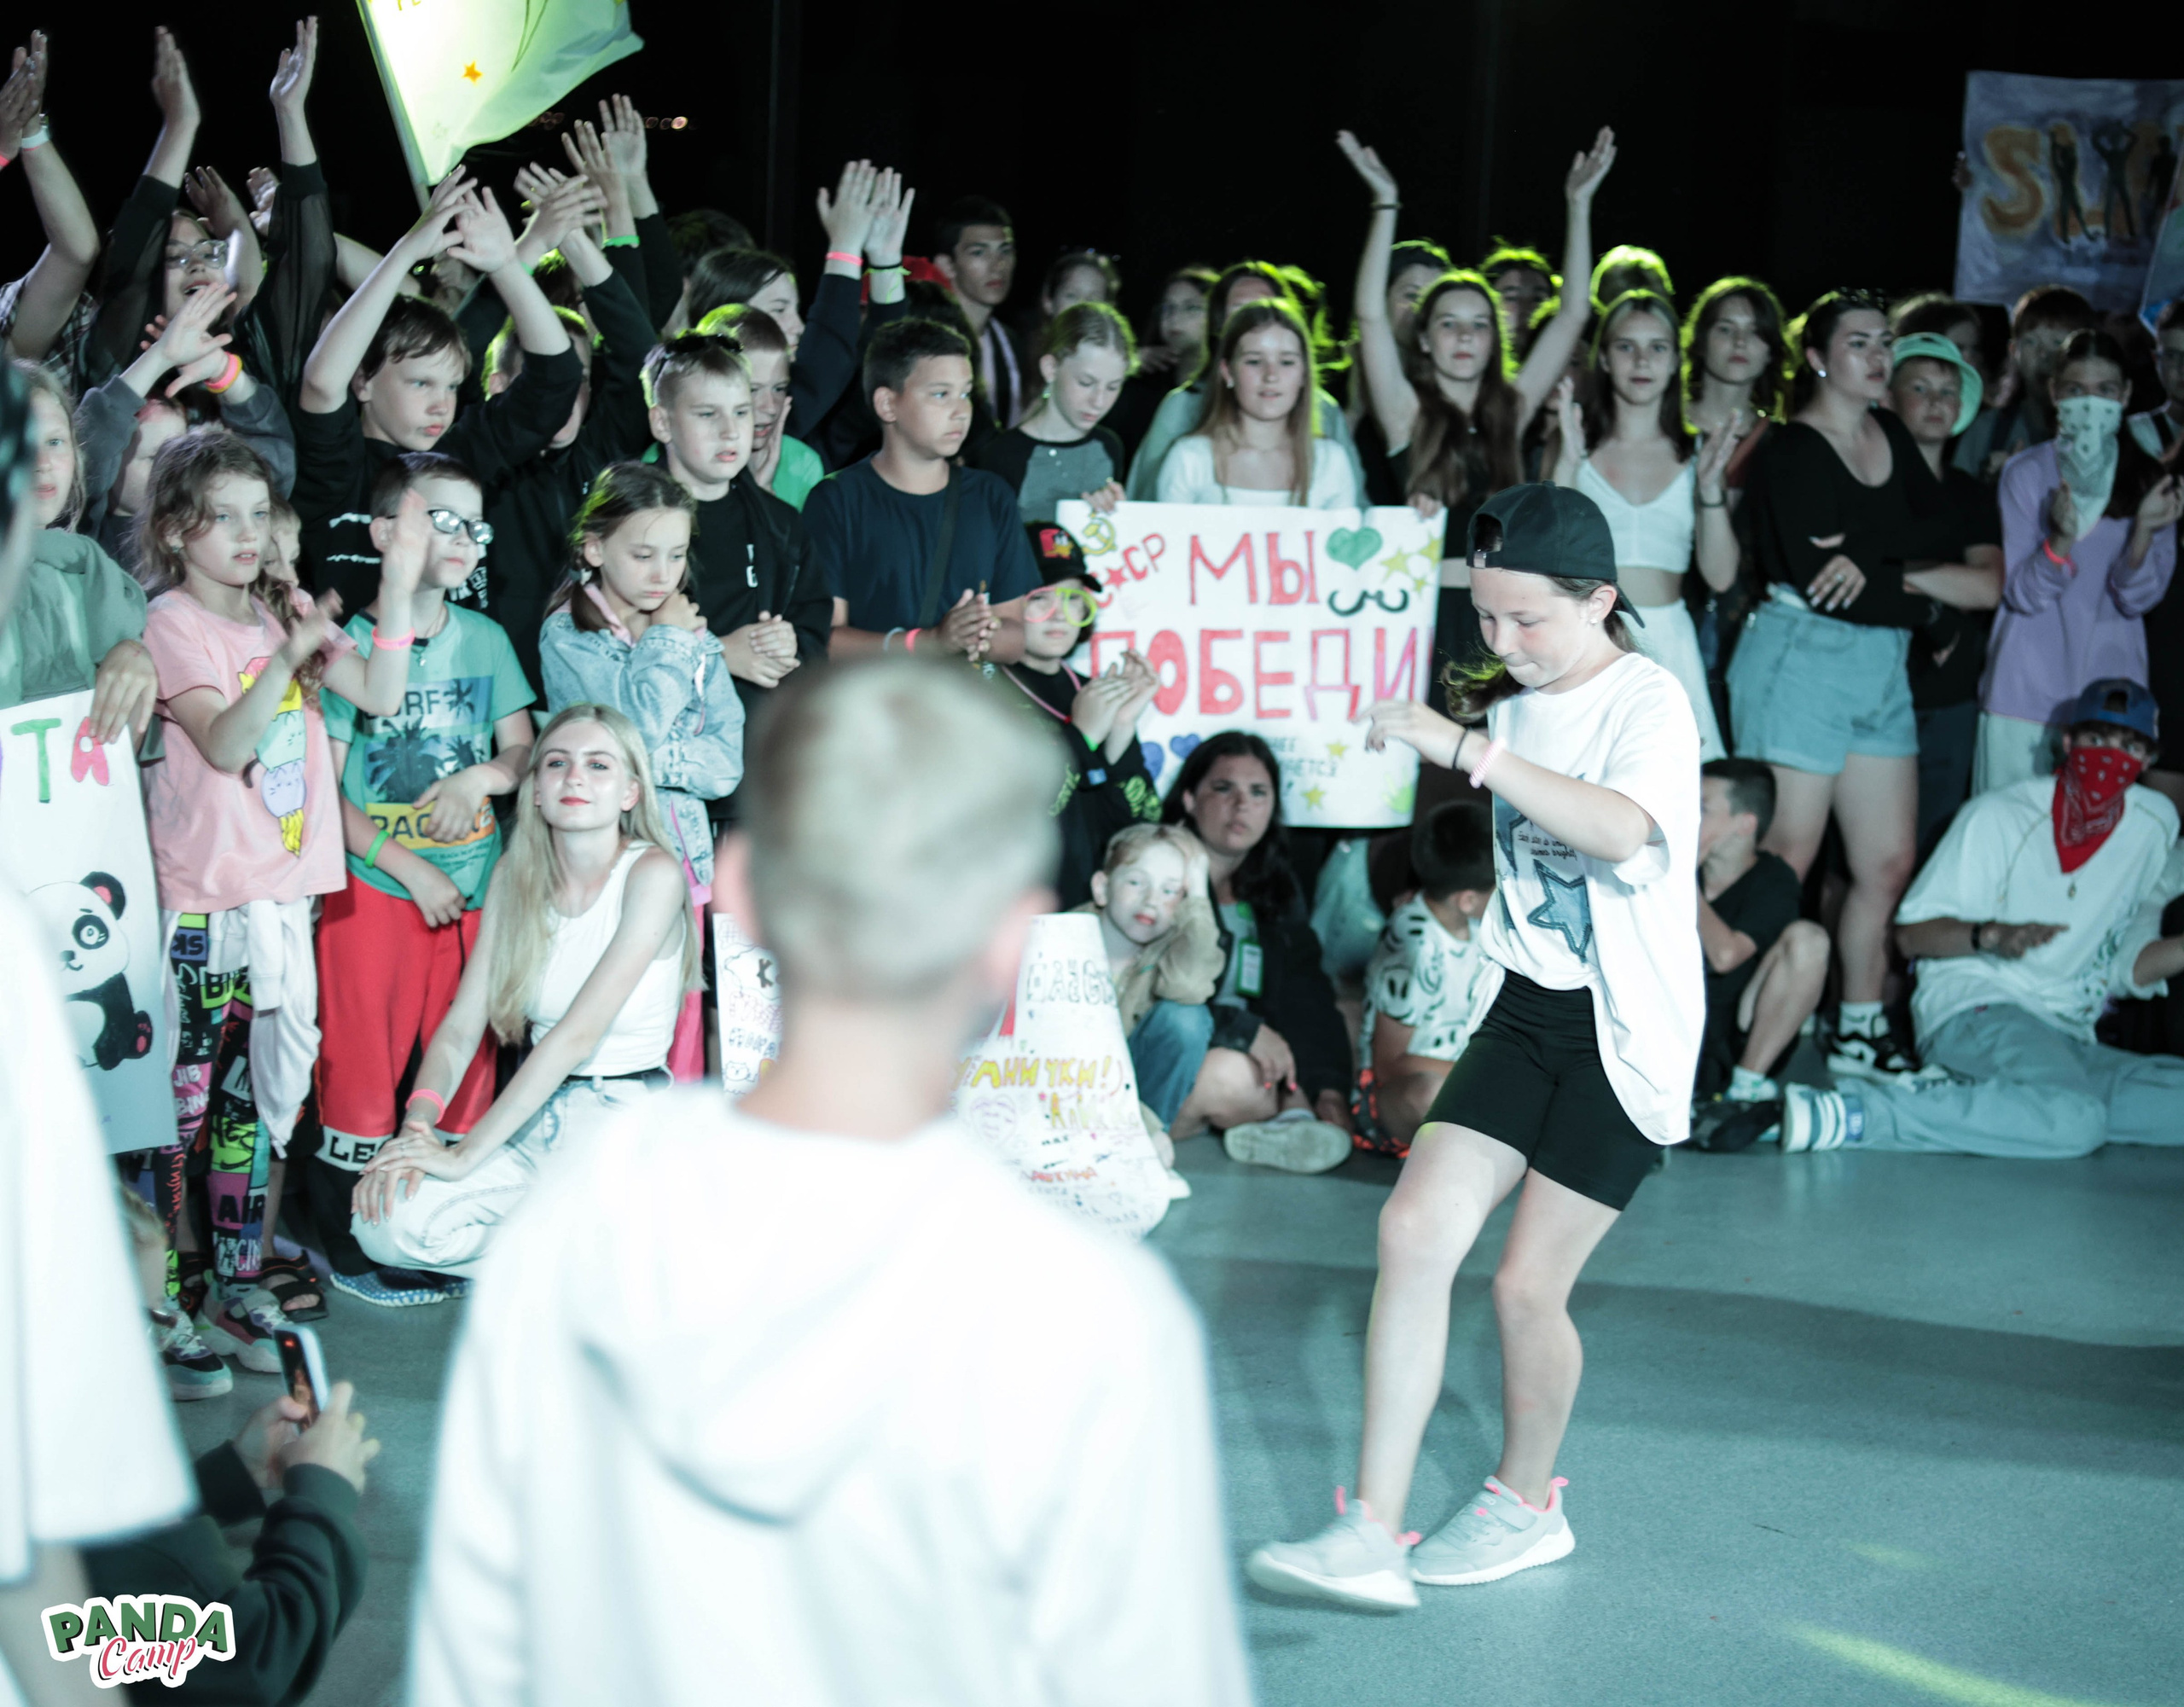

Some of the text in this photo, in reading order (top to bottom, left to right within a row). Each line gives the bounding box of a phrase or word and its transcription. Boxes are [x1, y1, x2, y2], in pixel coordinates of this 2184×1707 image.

[1189, 532, 1319, 605] МЫ
[1090, 626, 1432, 721] ПОБЕДИ
[0, 716, 110, 804] ТА
[329, 1135, 385, 1164] LE
